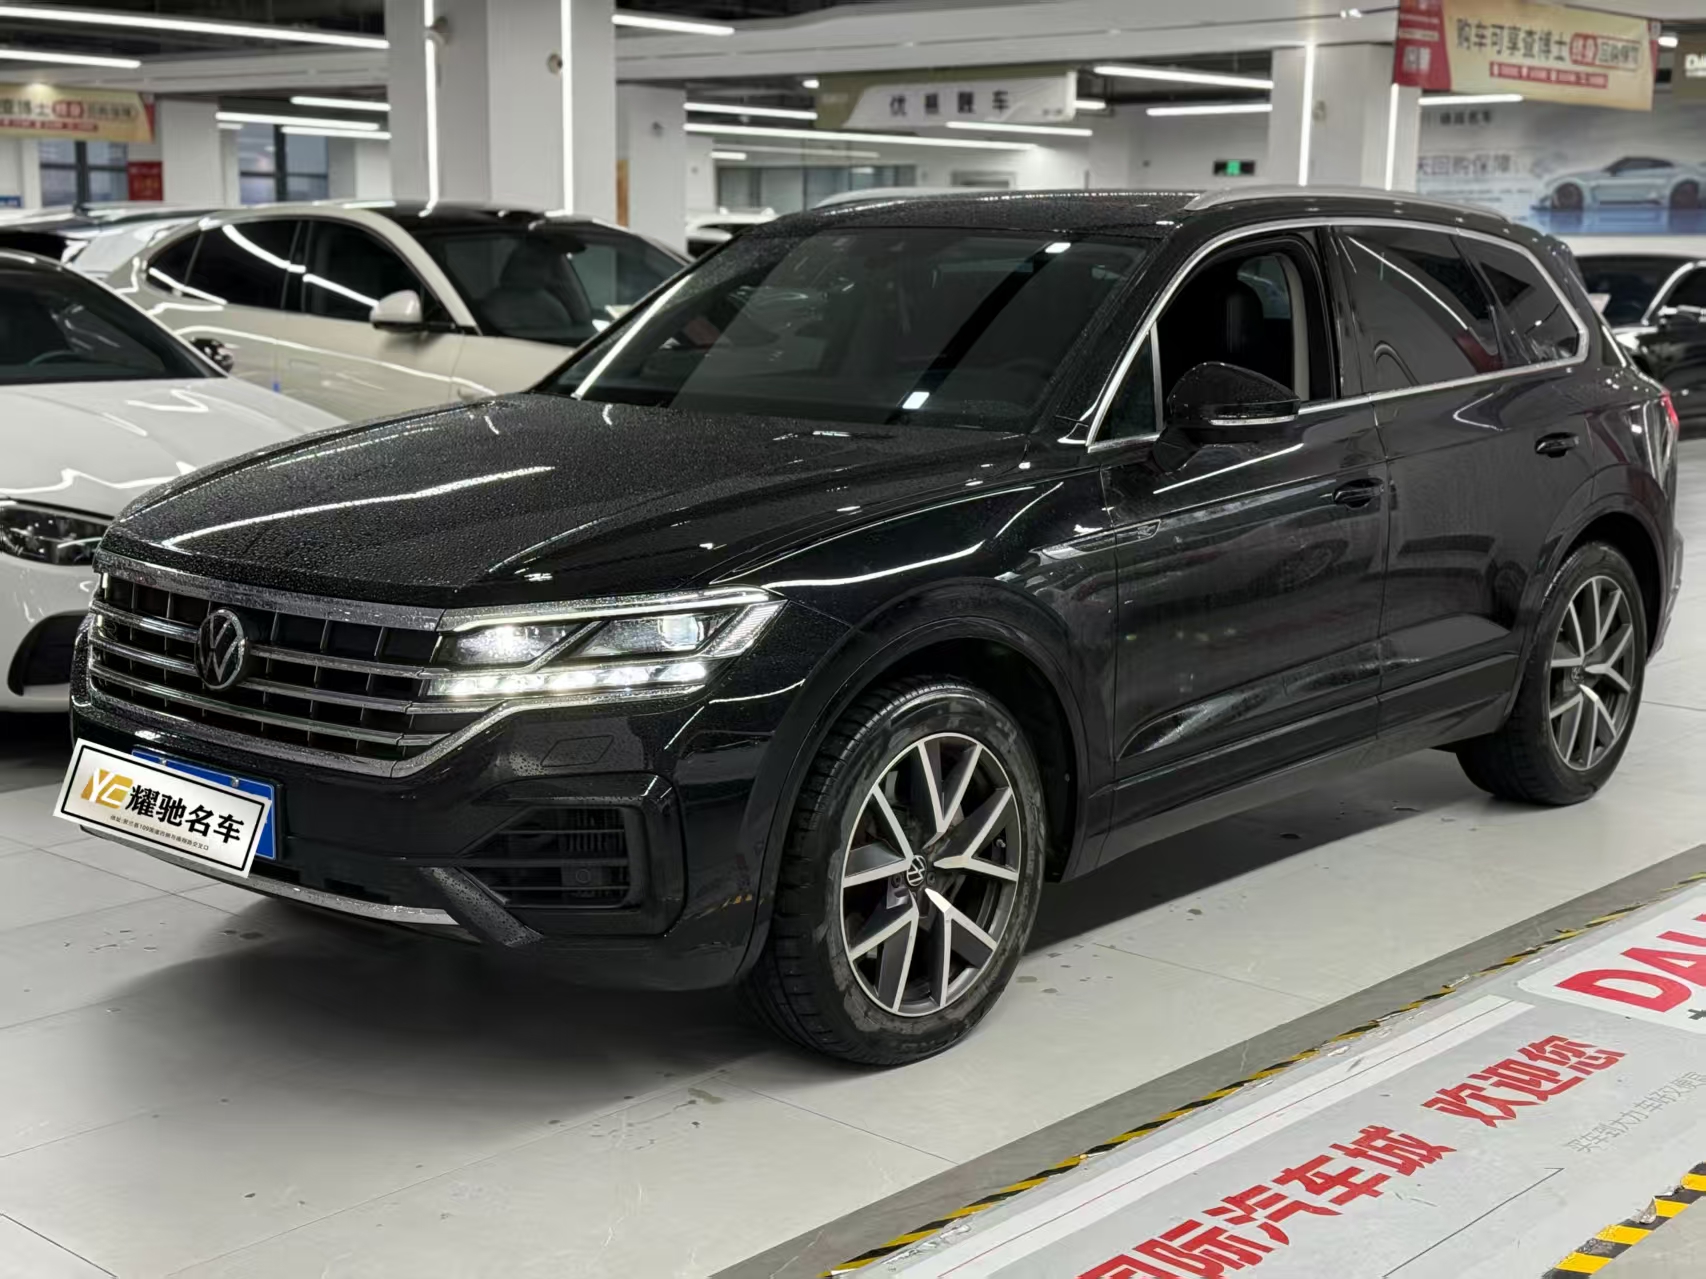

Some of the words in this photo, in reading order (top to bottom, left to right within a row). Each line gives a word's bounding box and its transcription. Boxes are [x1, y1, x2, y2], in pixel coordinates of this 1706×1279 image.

[1456, 18, 1568, 63] 购车可享查博士
[1420, 1035, 1626, 1128] 欢迎您
